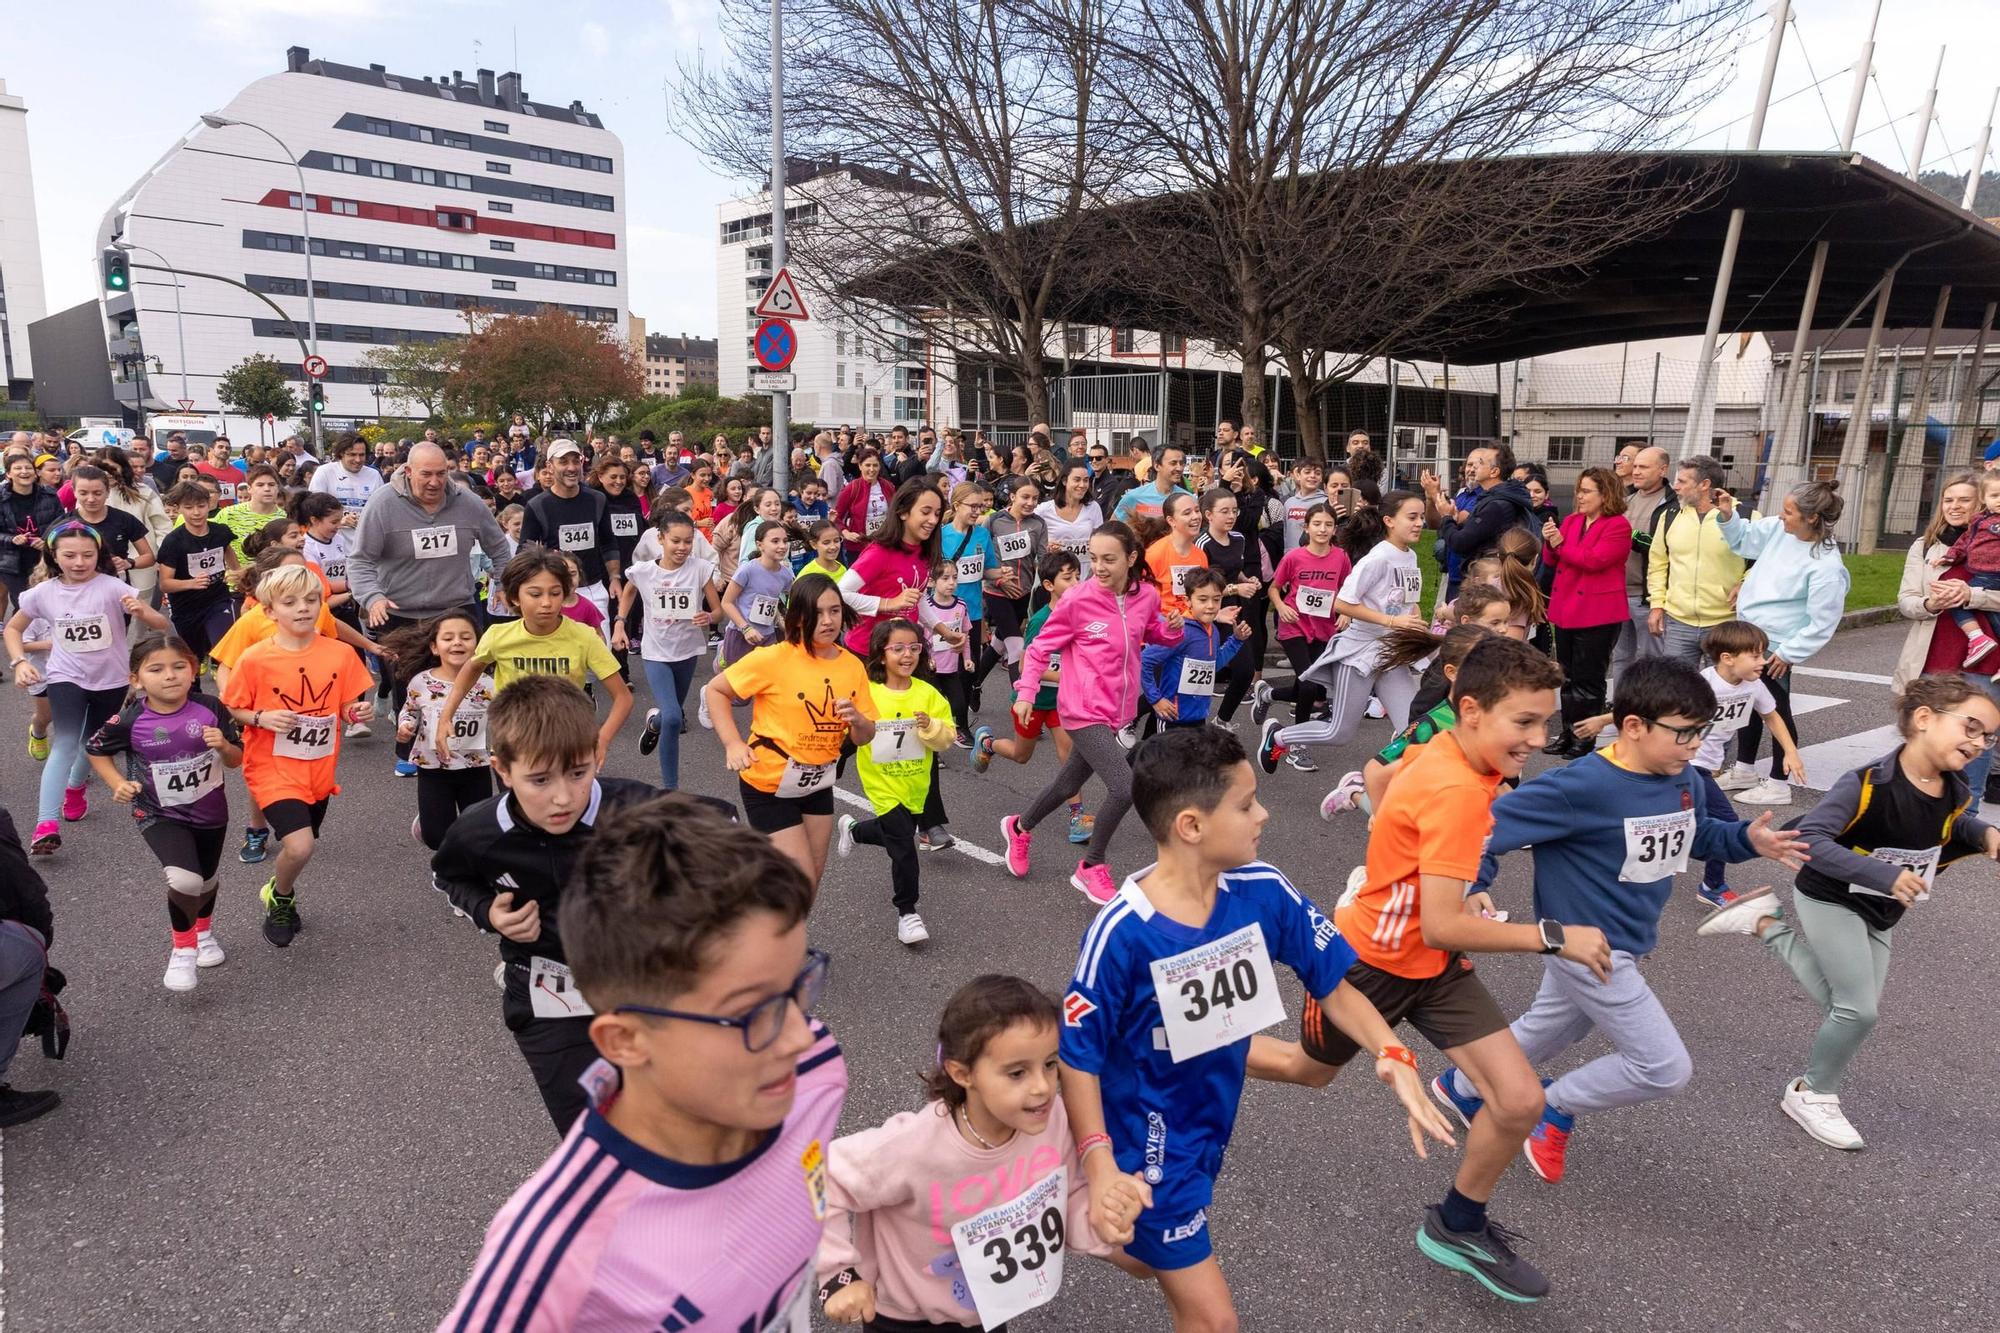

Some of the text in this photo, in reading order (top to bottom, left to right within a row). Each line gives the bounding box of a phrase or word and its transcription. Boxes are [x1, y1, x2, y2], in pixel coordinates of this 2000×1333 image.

[616, 520, 633, 529] 294
[421, 535, 449, 550] 217
[565, 531, 589, 543] 344
[1004, 539, 1026, 552] 308
[200, 557, 215, 568] 62
[326, 565, 345, 577] 432
[962, 562, 982, 575] 330
[1299, 571, 1336, 580] EMC
[1407, 577, 1419, 591] 246
[659, 595, 689, 609] 119
[1306, 595, 1323, 607] 95
[65, 625, 102, 641] 429
[513, 657, 569, 674] PUMA
[1188, 669, 1213, 684] 225
[1712, 702, 1747, 722] 247
[287, 727, 330, 746] 442
[893, 731, 905, 749] 7
[168, 763, 212, 792] 447
[798, 770, 825, 787] 55
[1639, 830, 1685, 862] 313
[1170, 955, 1196, 967] DOBLE
[1196, 947, 1220, 959] MILLA
[1220, 930, 1254, 949] SOLIDARIA
[1166, 959, 1208, 976] RETTANDO
[1219, 941, 1252, 956] SINDROME
[1166, 944, 1258, 984] DE RETT
[1181, 959, 1258, 1022] 340
[960, 1174, 1061, 1234] XI DOBLE MILLA SOLIDARIA
[966, 1184, 1059, 1238] RETTANDO AL SINDROME
[968, 1191, 1060, 1246] DE RETT
[983, 1206, 1064, 1284] 339
